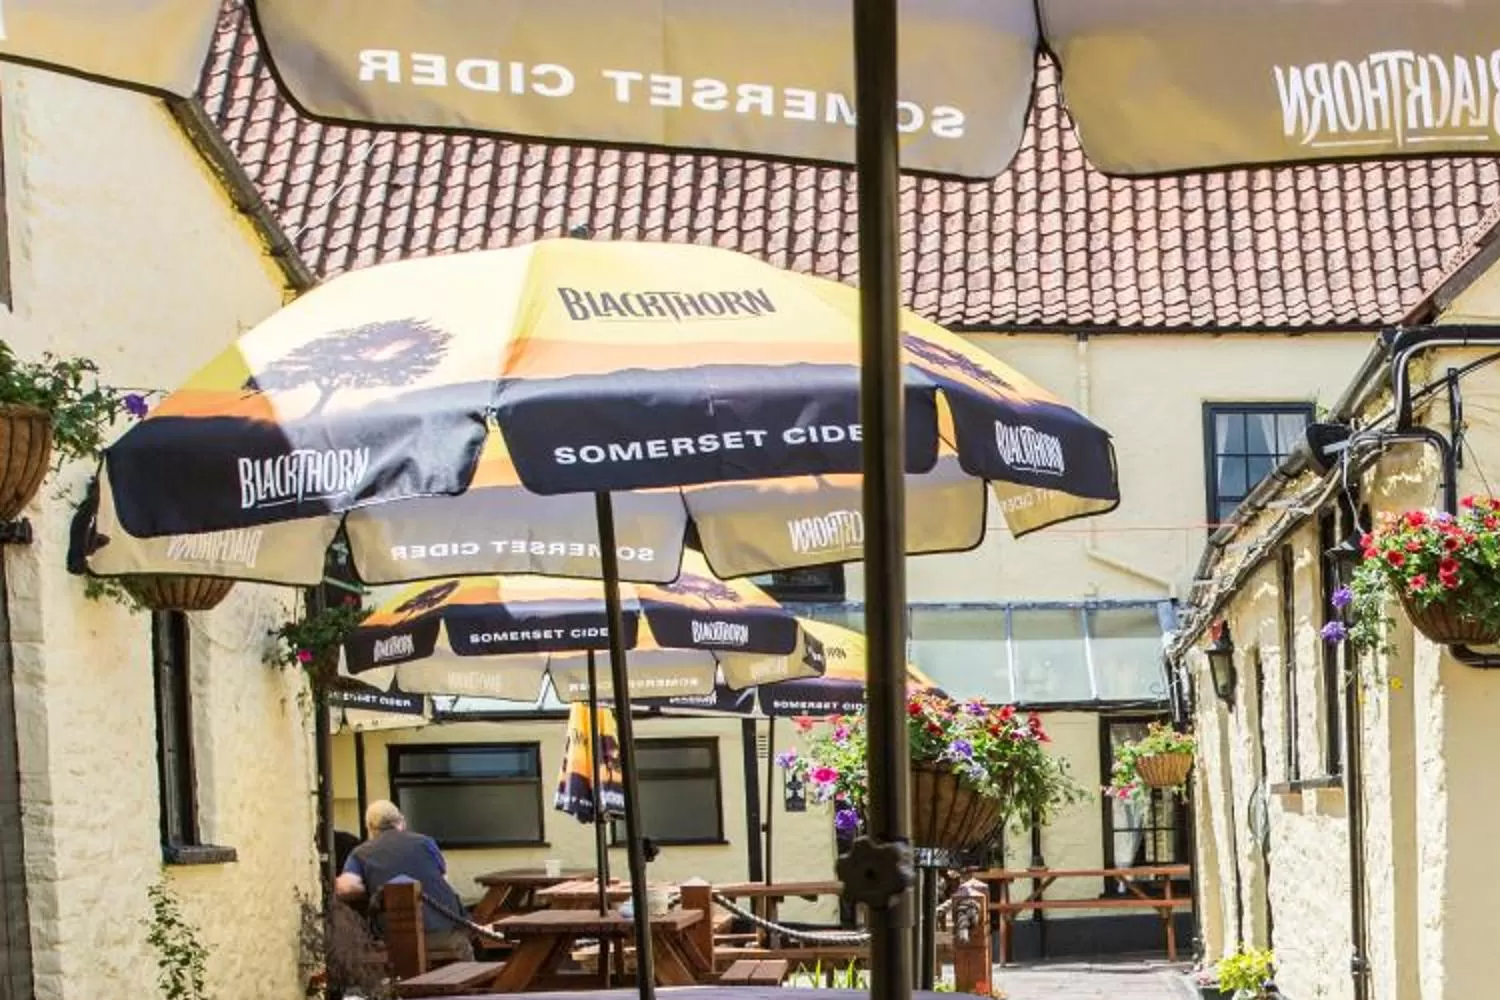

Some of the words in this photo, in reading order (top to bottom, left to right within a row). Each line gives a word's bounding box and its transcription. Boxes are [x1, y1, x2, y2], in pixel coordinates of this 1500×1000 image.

[557, 287, 777, 324] BLACKTHORN
[554, 430, 768, 465] SOMERSET
[782, 424, 864, 444] CIDE
[469, 629, 565, 644] SOMERSET
[571, 627, 609, 639] CIDE
